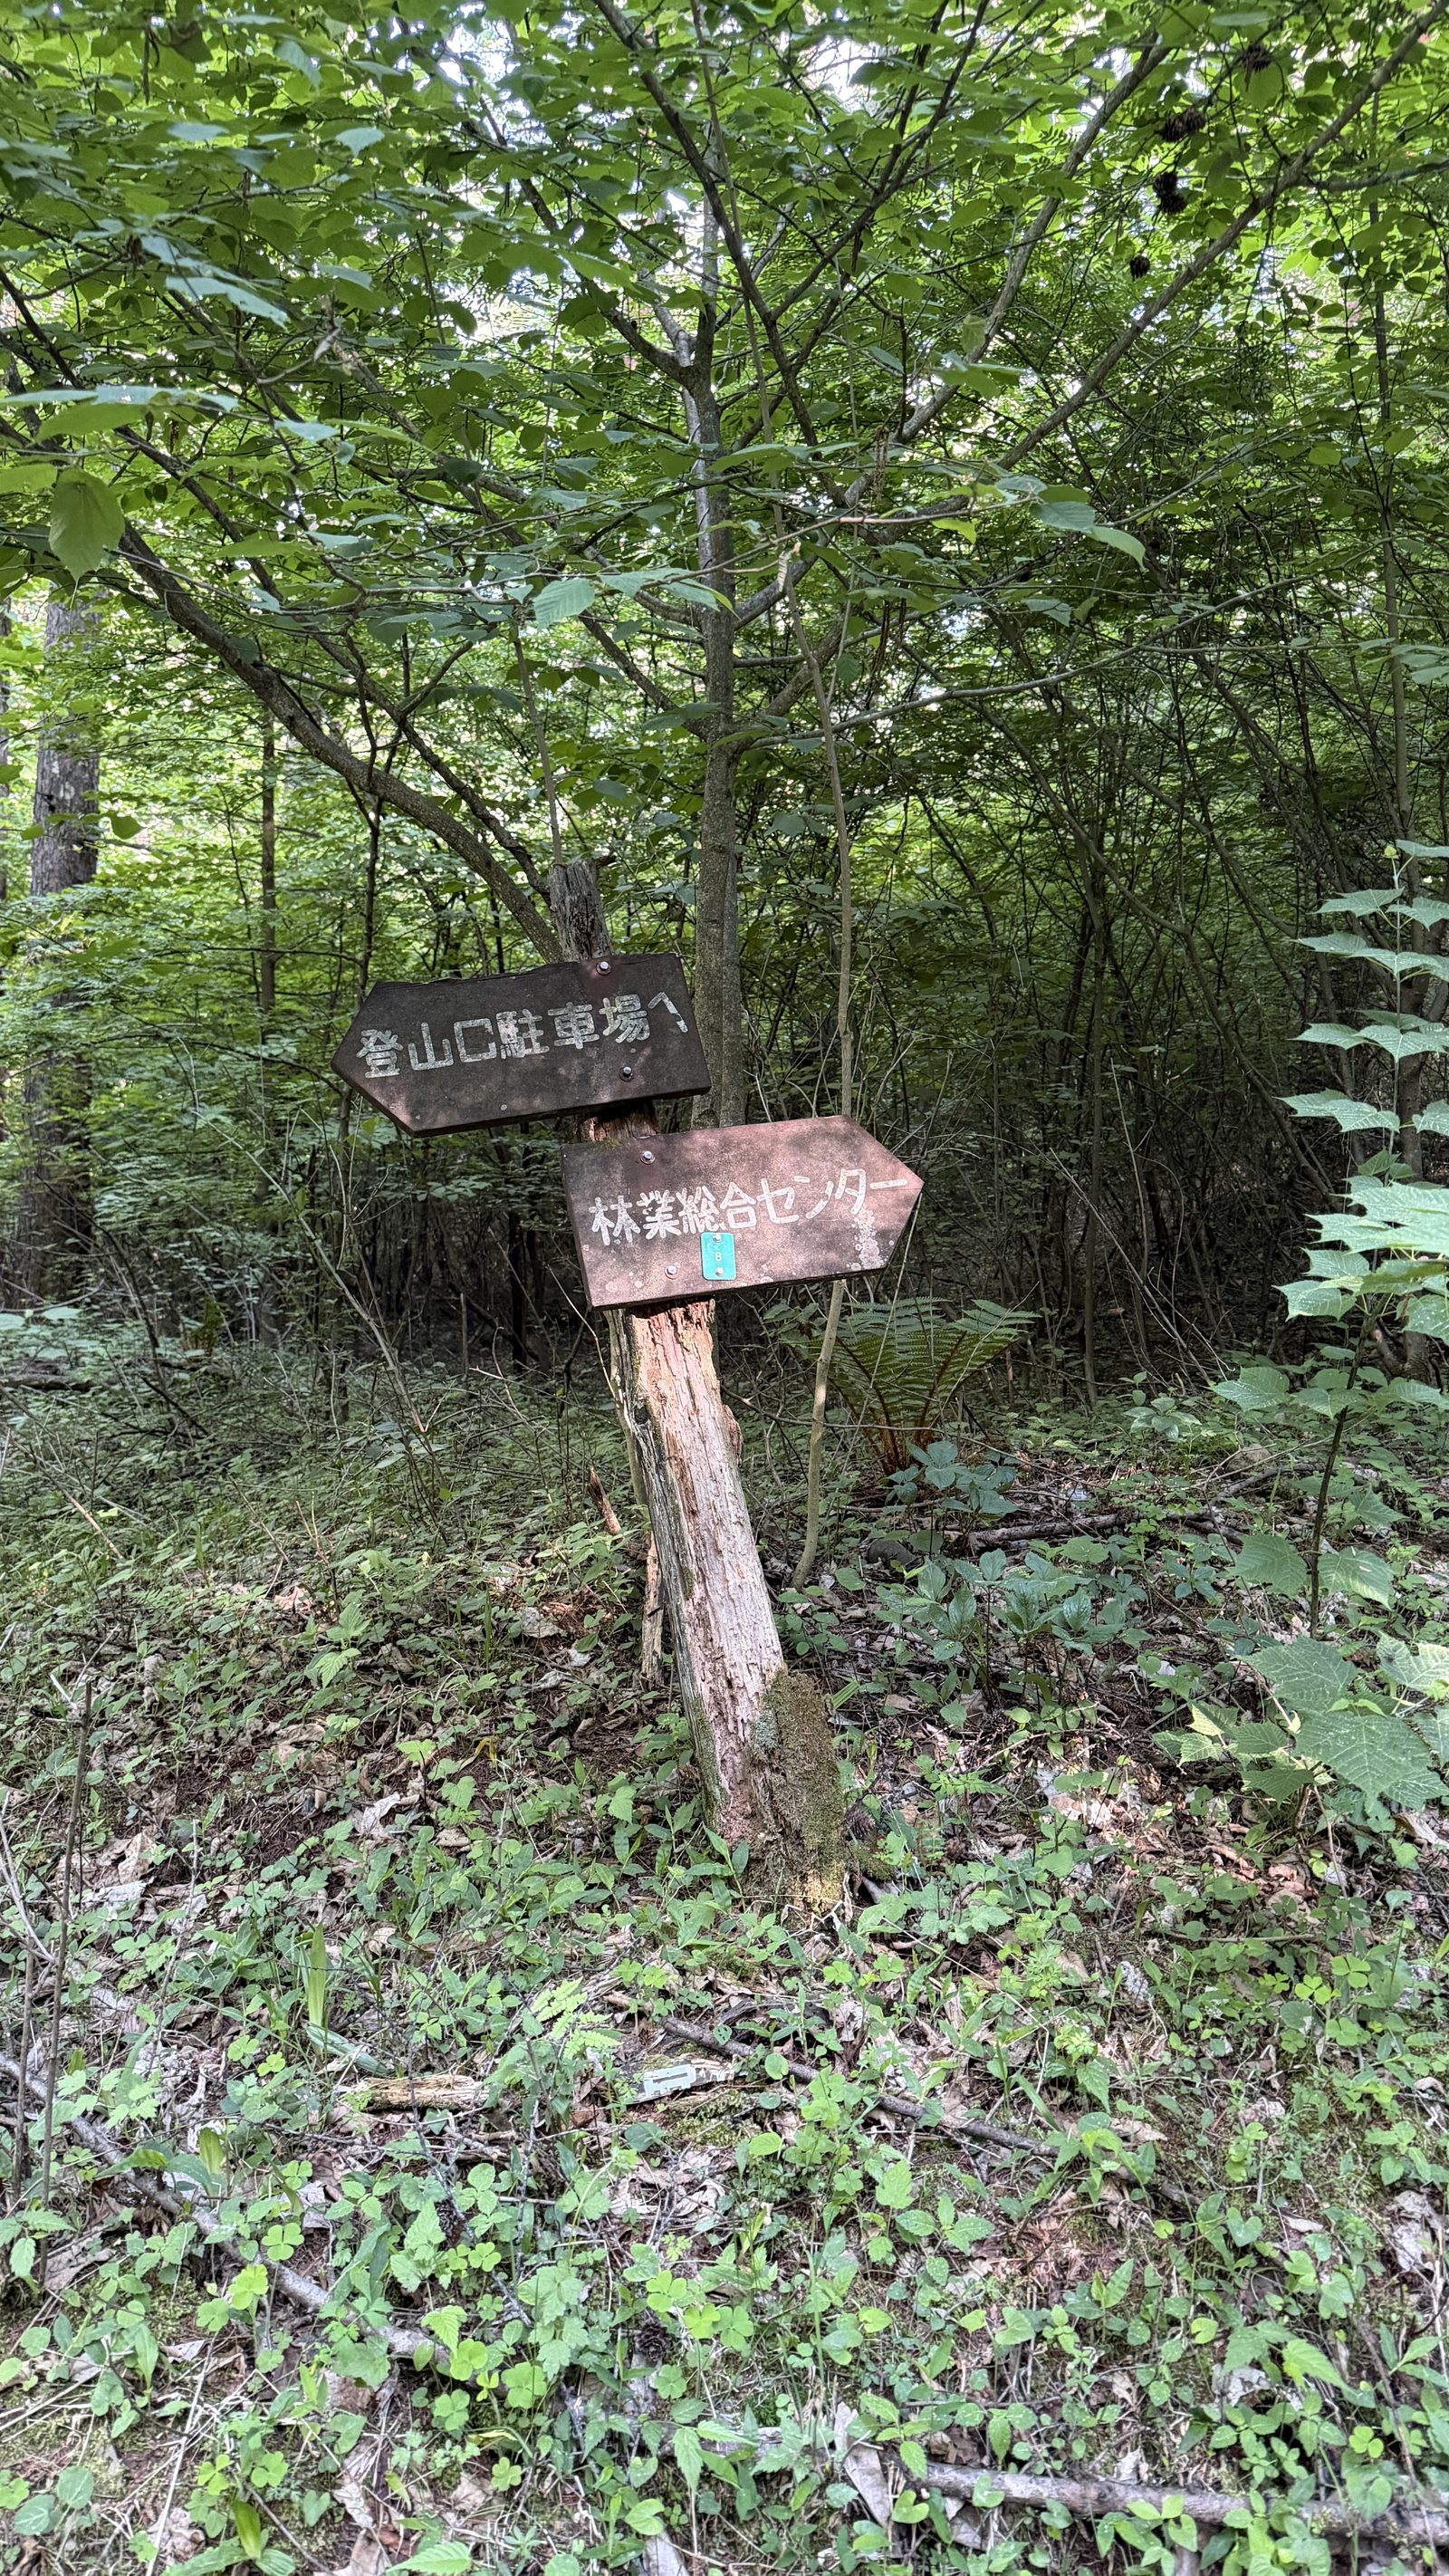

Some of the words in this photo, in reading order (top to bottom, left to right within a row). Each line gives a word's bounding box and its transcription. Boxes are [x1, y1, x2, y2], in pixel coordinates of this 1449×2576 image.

[356, 992, 688, 1078] 登山口駐車場へ
[589, 1168, 907, 1245] 林業総合センター
[715, 1252, 723, 1262] 8
